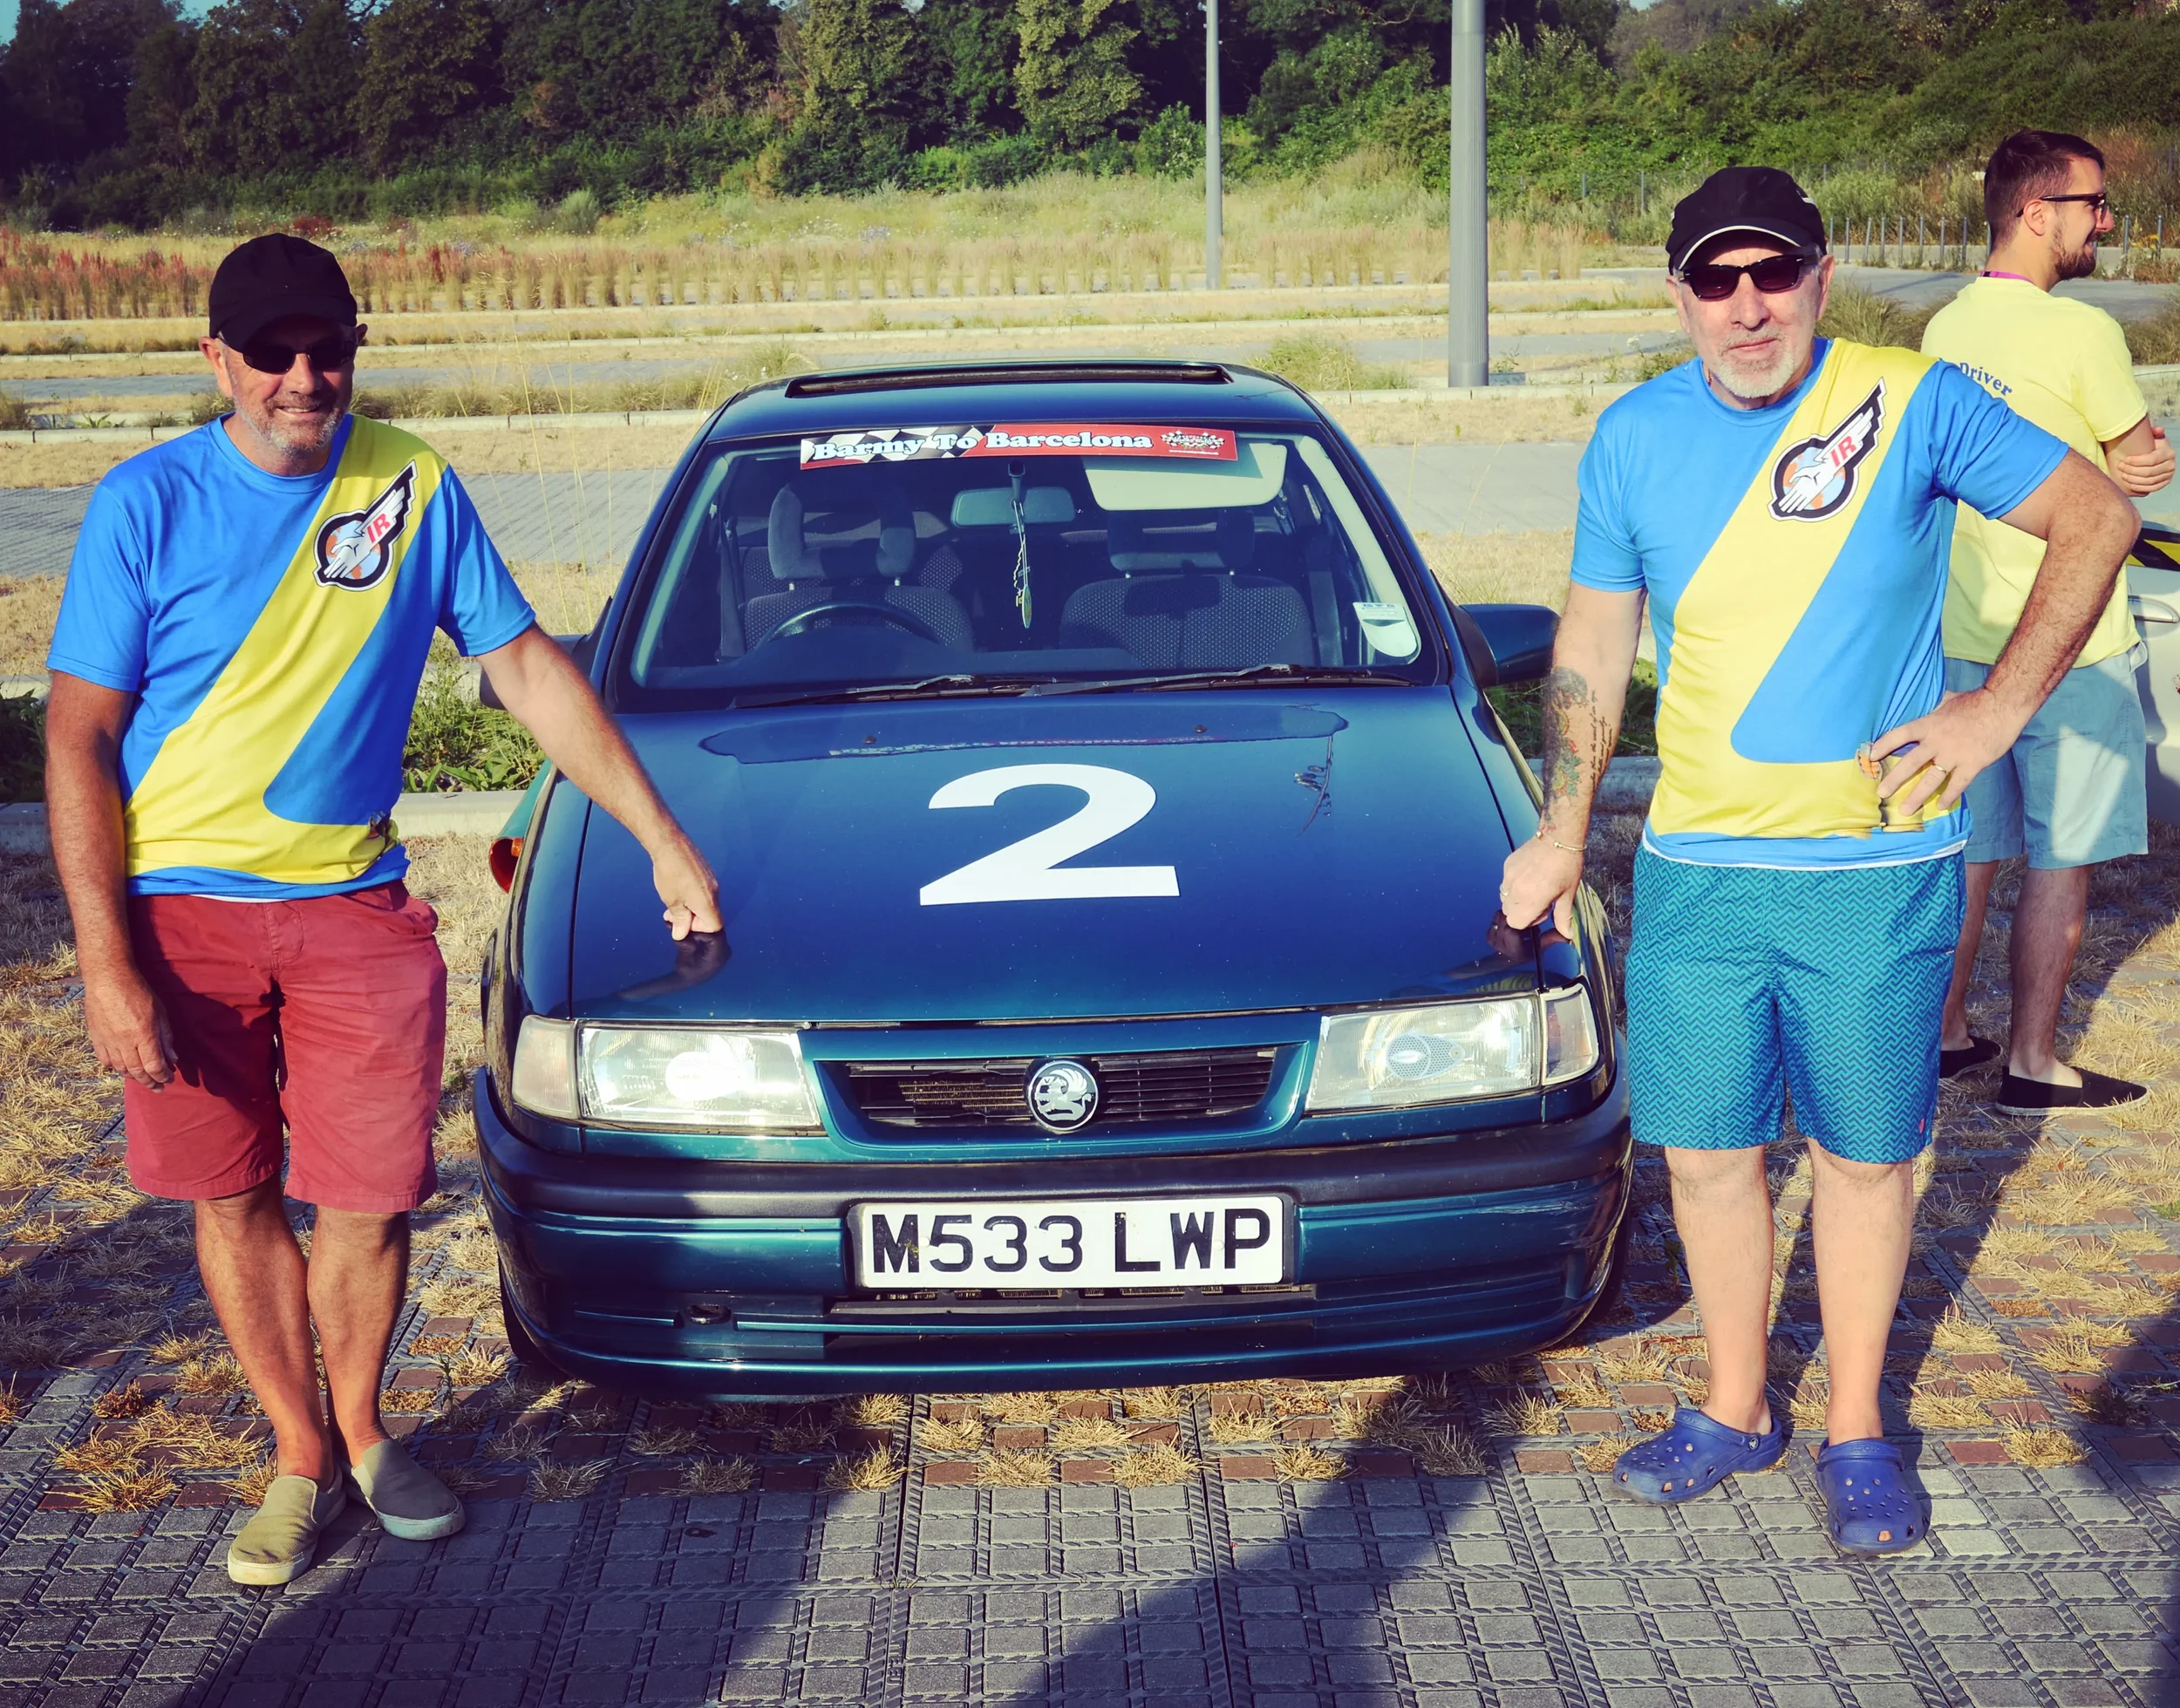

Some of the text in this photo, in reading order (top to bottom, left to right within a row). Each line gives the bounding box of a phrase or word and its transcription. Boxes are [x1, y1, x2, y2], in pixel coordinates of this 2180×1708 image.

[1959, 362, 2013, 396] Driver
[813, 439, 926, 459] Barmy
[933, 432, 978, 450] To
[985, 432, 1154, 448] Barcelona
[1830, 436, 1856, 467] IR
[367, 513, 391, 544] IR
[920, 764, 1180, 906] 2
[872, 1208, 1271, 1273] M533 LWP
